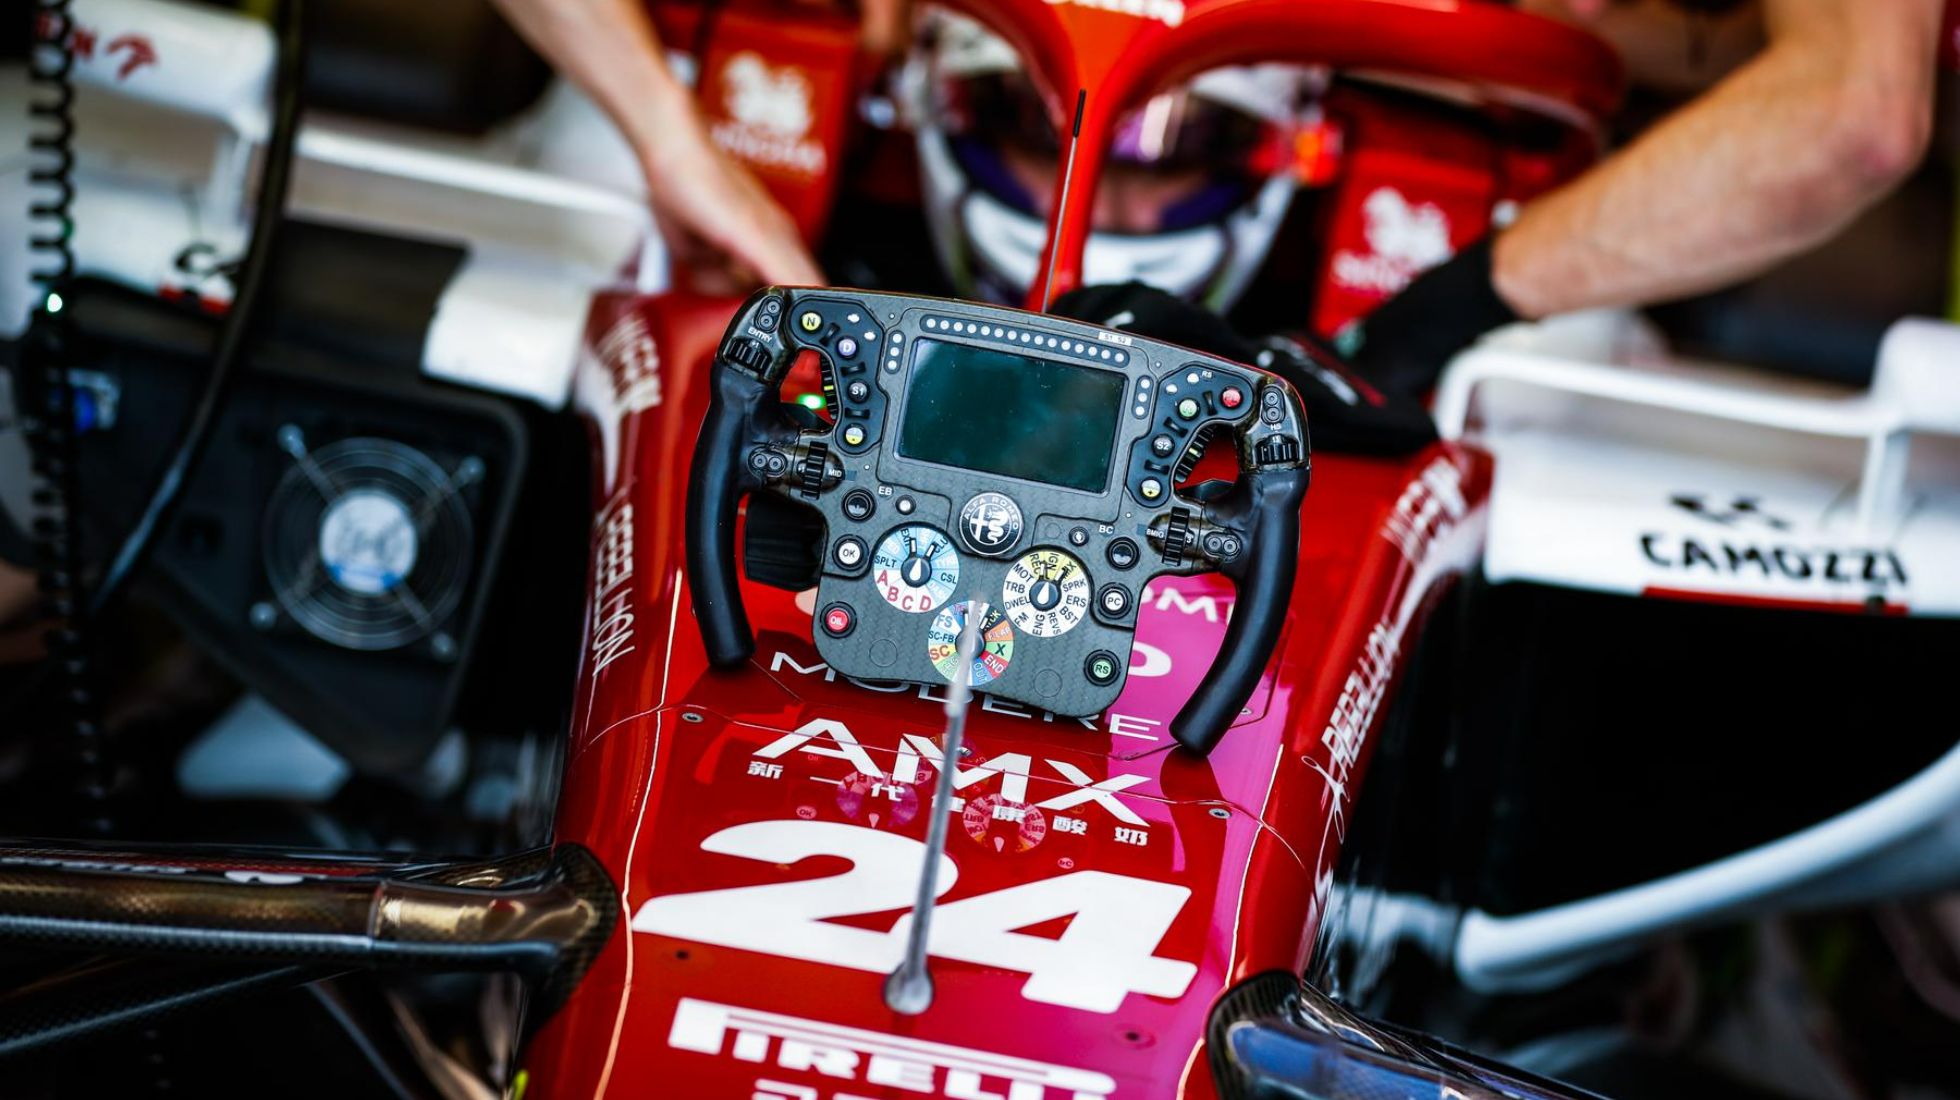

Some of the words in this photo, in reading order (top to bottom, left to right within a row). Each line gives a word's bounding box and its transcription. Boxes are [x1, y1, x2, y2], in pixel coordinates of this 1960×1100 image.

[806, 317, 816, 327] N
[843, 343, 852, 354] D
[852, 385, 864, 396] S1
[1156, 441, 1169, 451] S2
[878, 485, 893, 496] EB
[963, 497, 986, 521] ALFA
[991, 496, 1019, 530] ROMEO
[1098, 524, 1114, 535] BC
[842, 548, 856, 558] OK
[1639, 531, 1909, 587] CAMOZZI
[875, 554, 898, 568] SPLT
[877, 569, 889, 587] A
[940, 571, 957, 585] CSL
[1012, 563, 1035, 583] MOT
[1005, 580, 1026, 594] TRB
[1062, 578, 1087, 593] SPRK
[887, 586, 899, 602] B
[1066, 594, 1087, 609] ERS
[1107, 596, 1121, 607] PC
[902, 595, 914, 611] C
[919, 596, 932, 611] D
[1004, 595, 1031, 611] DWEL
[936, 614, 954, 628] FS
[1059, 605, 1079, 625] BST
[1033, 614, 1045, 636] ENG
[1048, 612, 1062, 635] REVS
[928, 630, 955, 643] SC-FB
[929, 644, 950, 660] SC
[994, 643, 1006, 656] X
[984, 655, 1005, 674] END
[1095, 664, 1109, 675] RS
[752, 717, 1152, 827] AMX
[632, 820, 1198, 1013] 24
